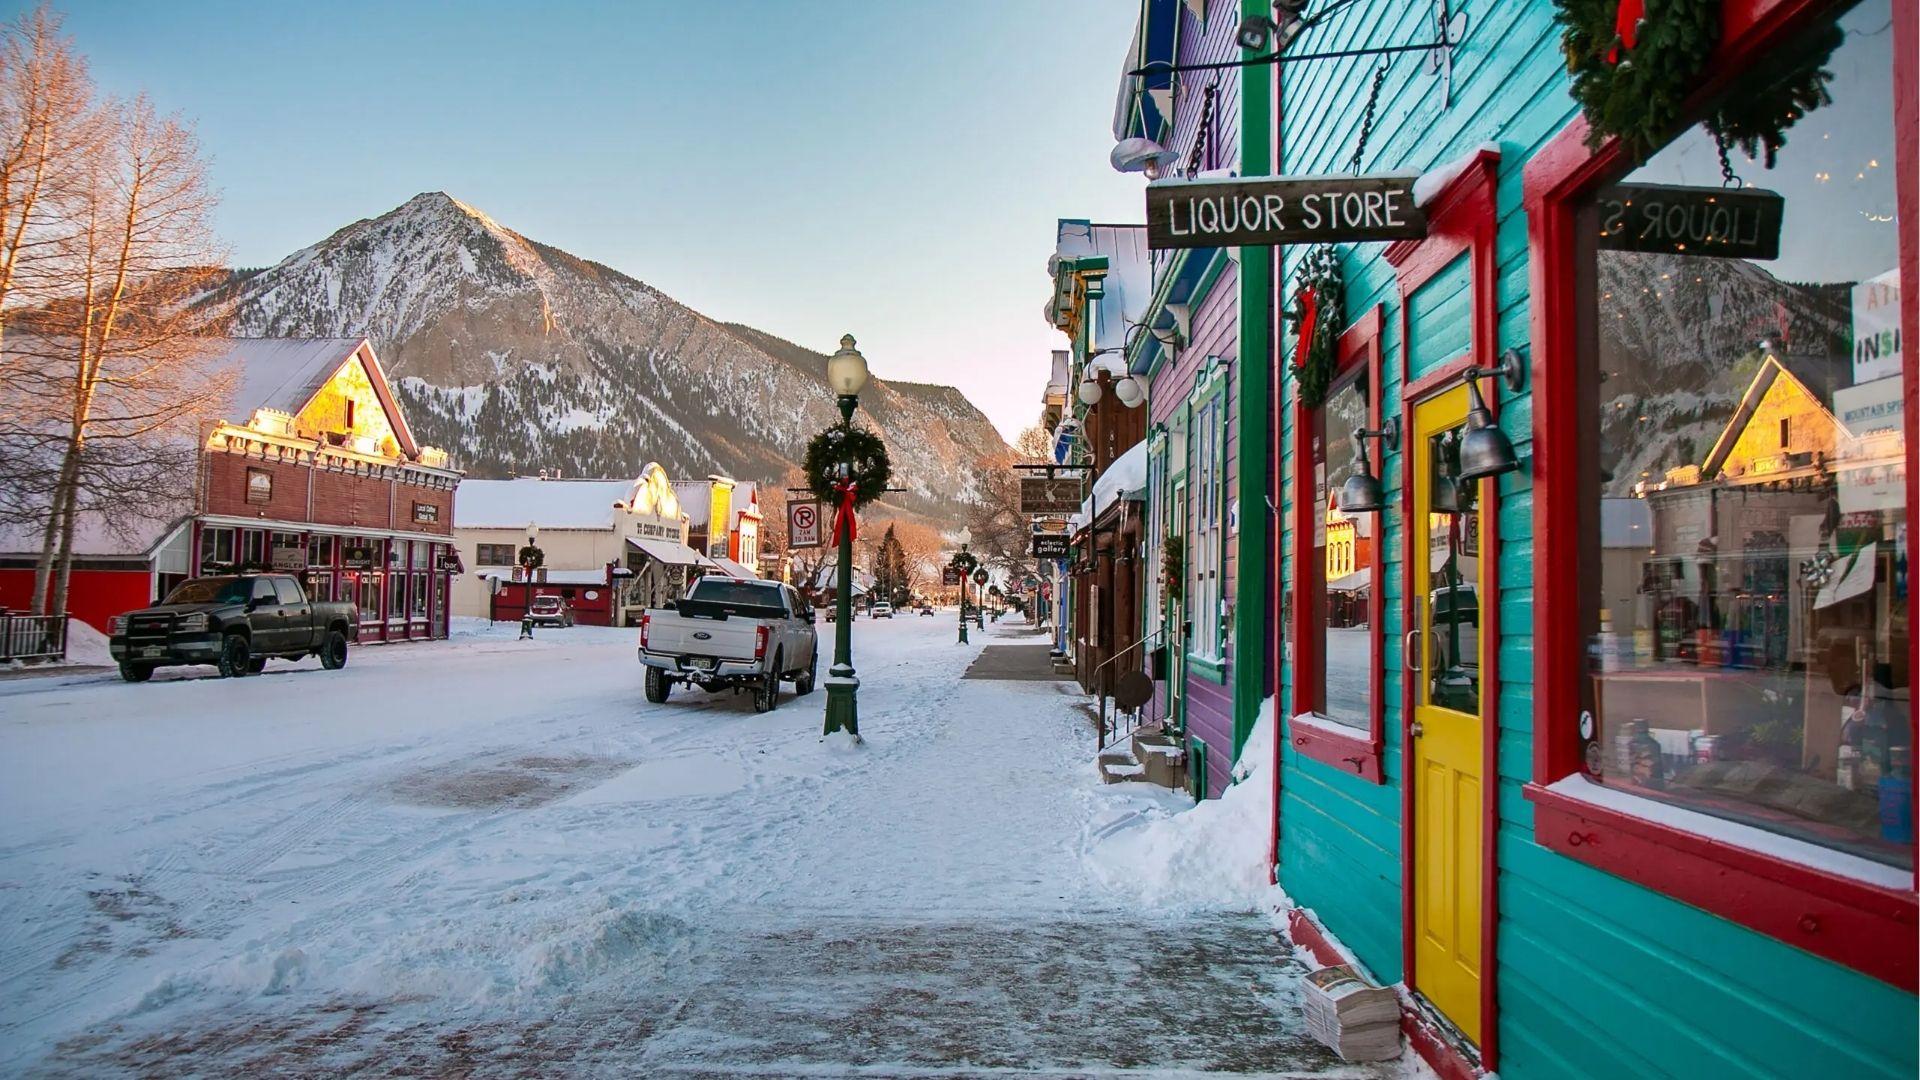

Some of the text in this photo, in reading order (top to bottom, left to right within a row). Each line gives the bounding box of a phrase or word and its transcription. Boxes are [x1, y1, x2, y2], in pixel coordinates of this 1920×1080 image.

[1169, 189, 1405, 236] LIQUOR STORE
[643, 523, 665, 537] COMPANY
[1037, 544, 1066, 554] gallery
